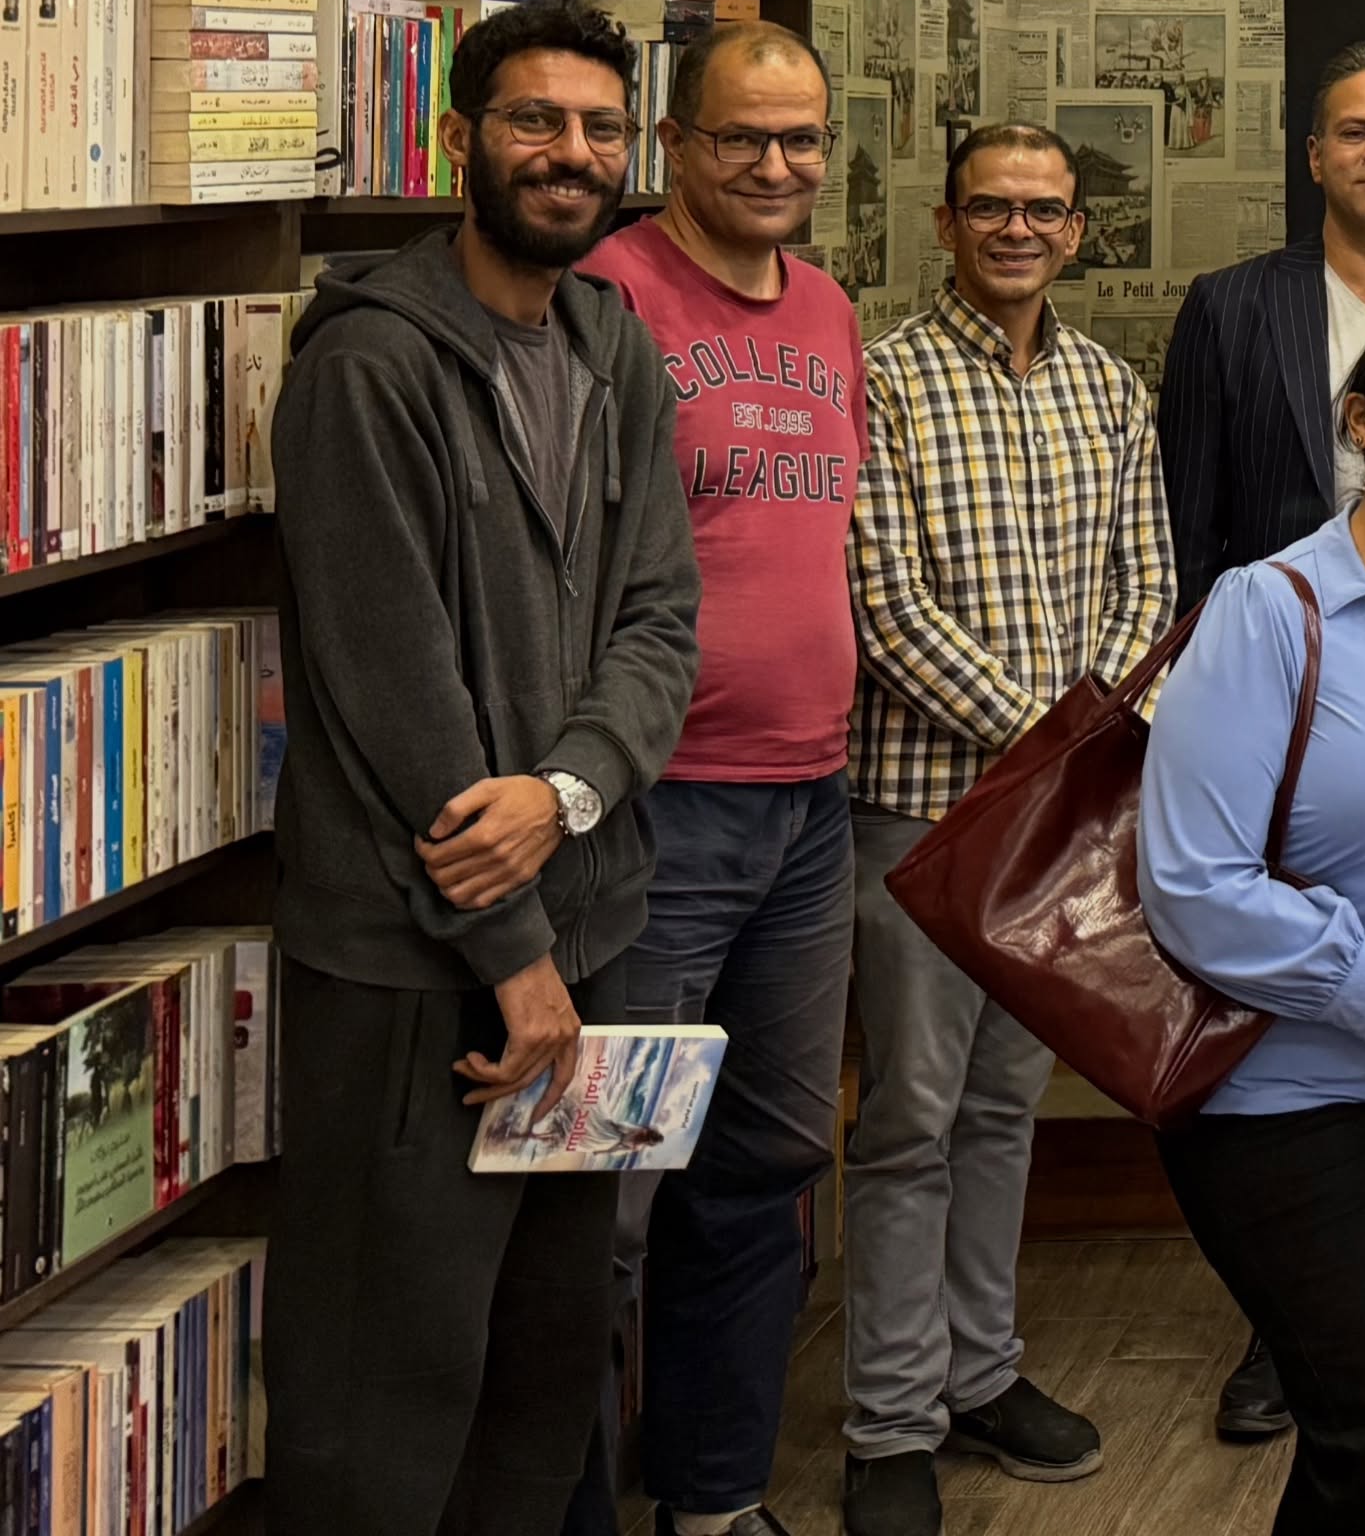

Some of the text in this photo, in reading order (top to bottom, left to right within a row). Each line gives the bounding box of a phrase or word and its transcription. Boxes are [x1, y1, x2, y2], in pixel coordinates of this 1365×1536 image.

[1098, 281, 1114, 298] Le
[1123, 281, 1154, 298] Petit
[663, 335, 847, 418] COLLEGE
[732, 402, 813, 436] EST.1995
[690, 445, 846, 504] LEAGUE
[566, 1056, 610, 1152] سامح الفؤاد
